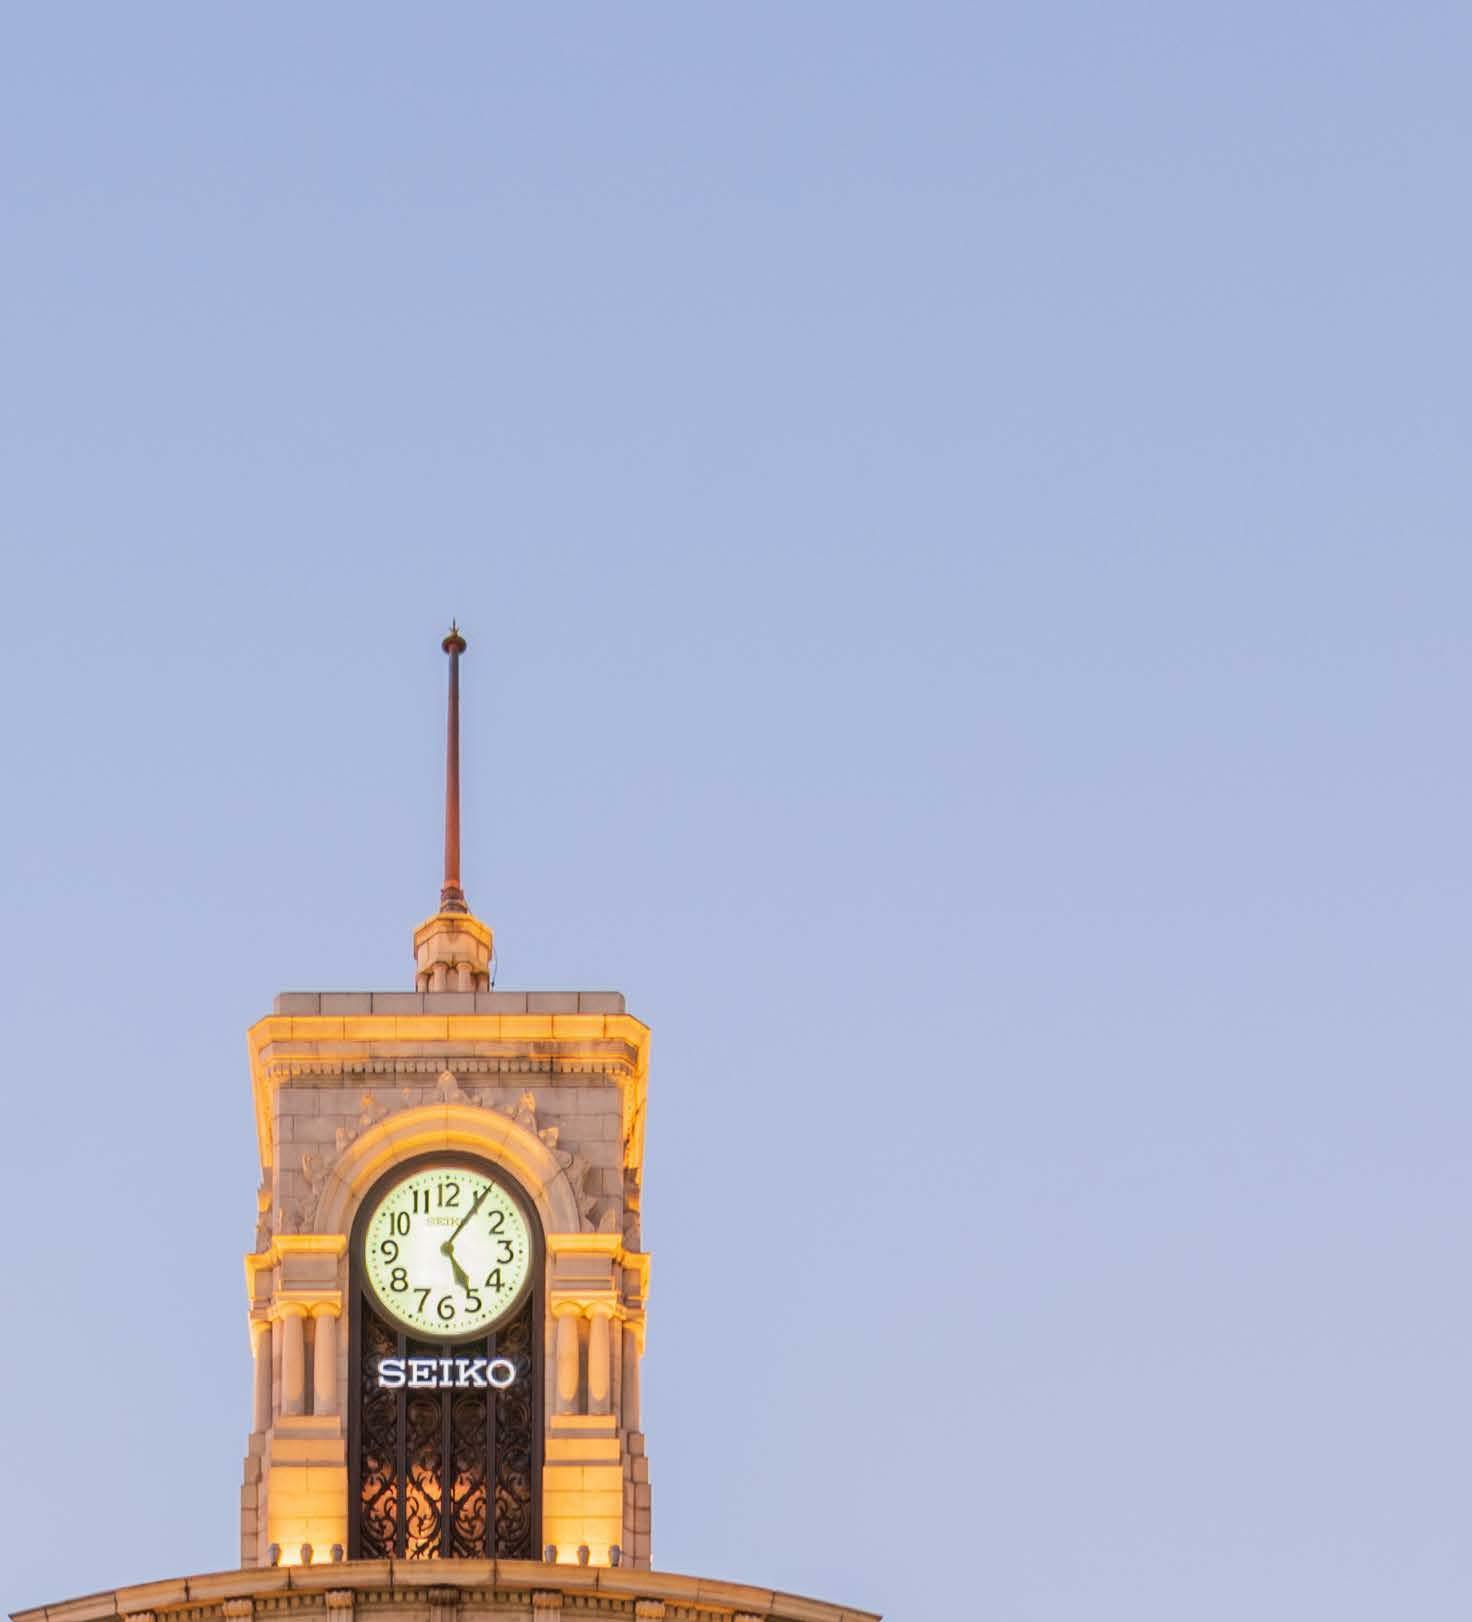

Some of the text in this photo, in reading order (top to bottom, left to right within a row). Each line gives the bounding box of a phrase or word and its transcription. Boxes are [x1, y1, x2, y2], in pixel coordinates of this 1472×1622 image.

[413, 1189, 429, 1214] 11
[437, 1182, 460, 1207] 12
[389, 1211, 411, 1236] 10
[488, 1210, 505, 1235] 2
[380, 1239, 399, 1264] 9
[496, 1240, 514, 1264] 3
[390, 1267, 409, 1292] 8
[485, 1268, 505, 1293] 4
[413, 1288, 431, 1313] 7
[437, 1295, 455, 1320] 6
[464, 1288, 482, 1313] 5
[378, 1358, 516, 1388] SEIKO
